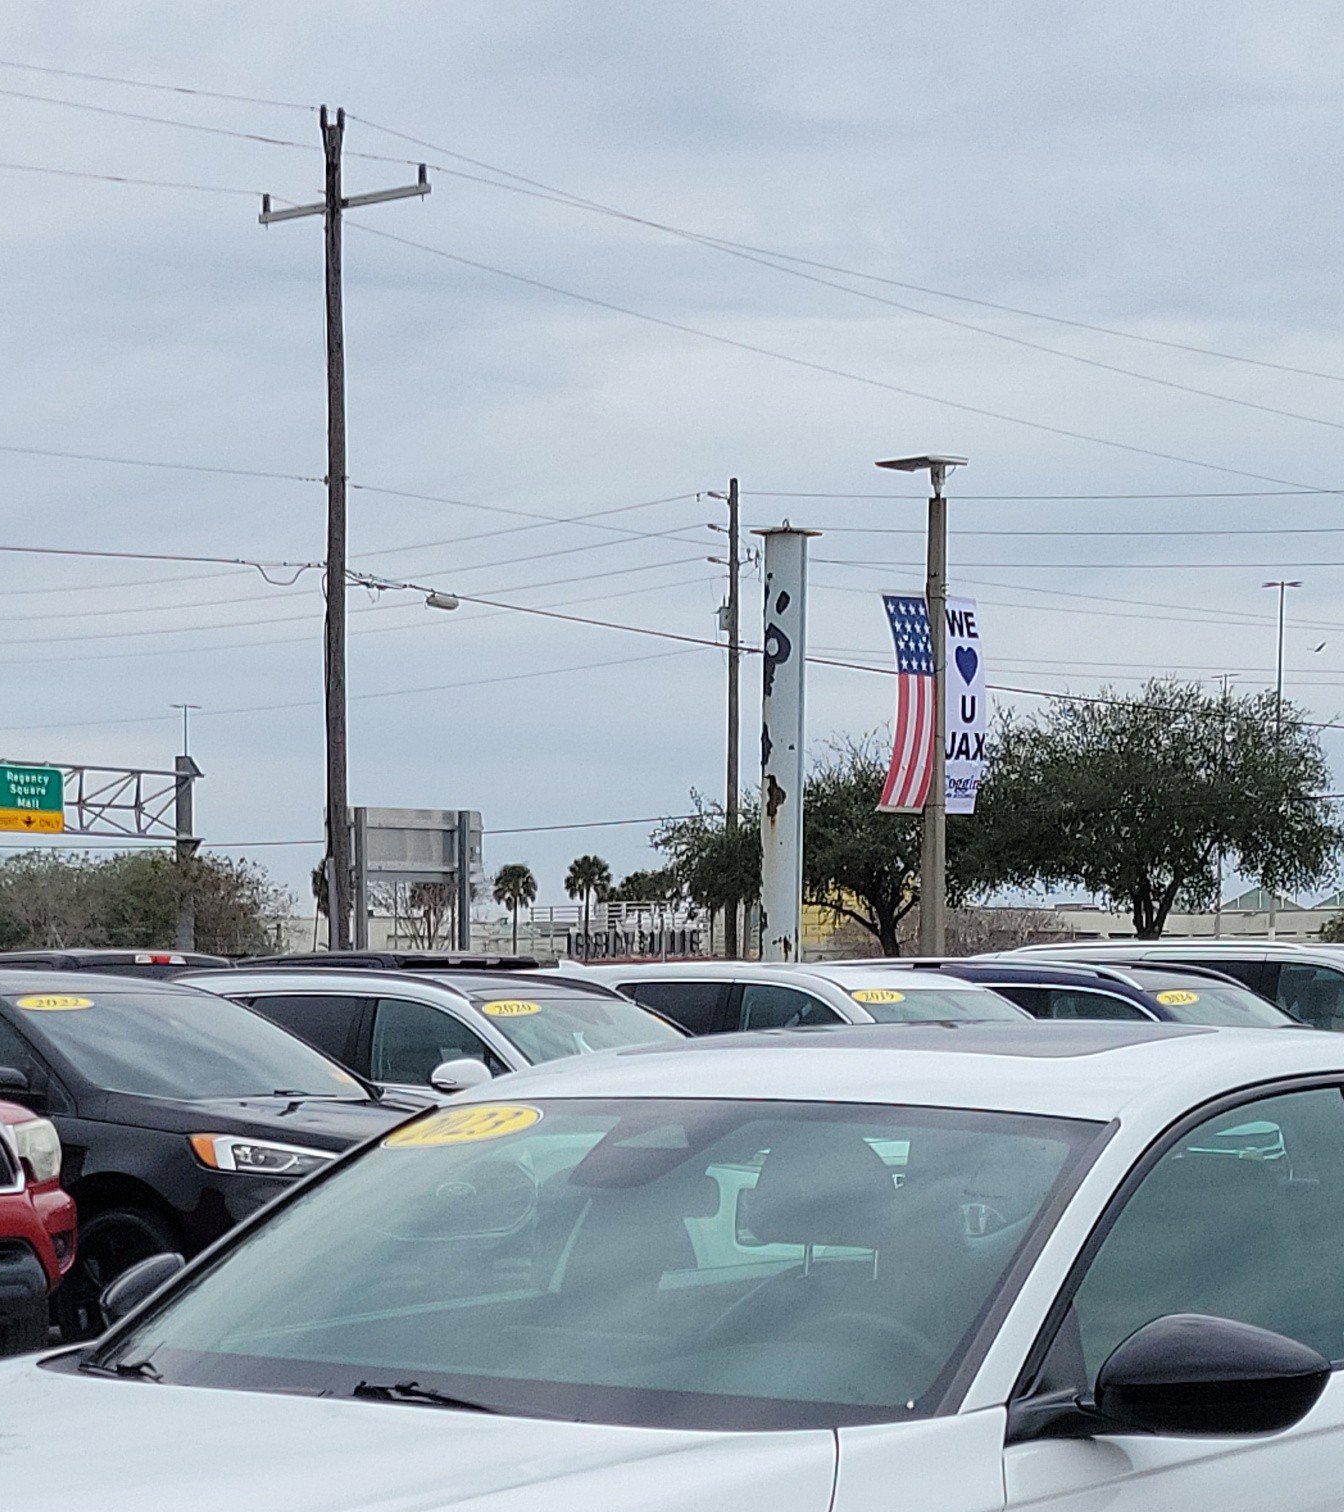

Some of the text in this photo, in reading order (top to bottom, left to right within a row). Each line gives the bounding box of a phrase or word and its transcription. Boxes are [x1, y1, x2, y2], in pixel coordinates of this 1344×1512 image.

[945, 609, 979, 638] WE
[961, 694, 976, 724] U
[945, 731, 986, 761] JAX
[6, 770, 49, 786] Regency
[9, 783, 47, 797] Square
[17, 796, 40, 809] Mall
[39, 818, 61, 829] ONLY
[36, 998, 81, 1008] 2022
[494, 1002, 532, 1015] 2020
